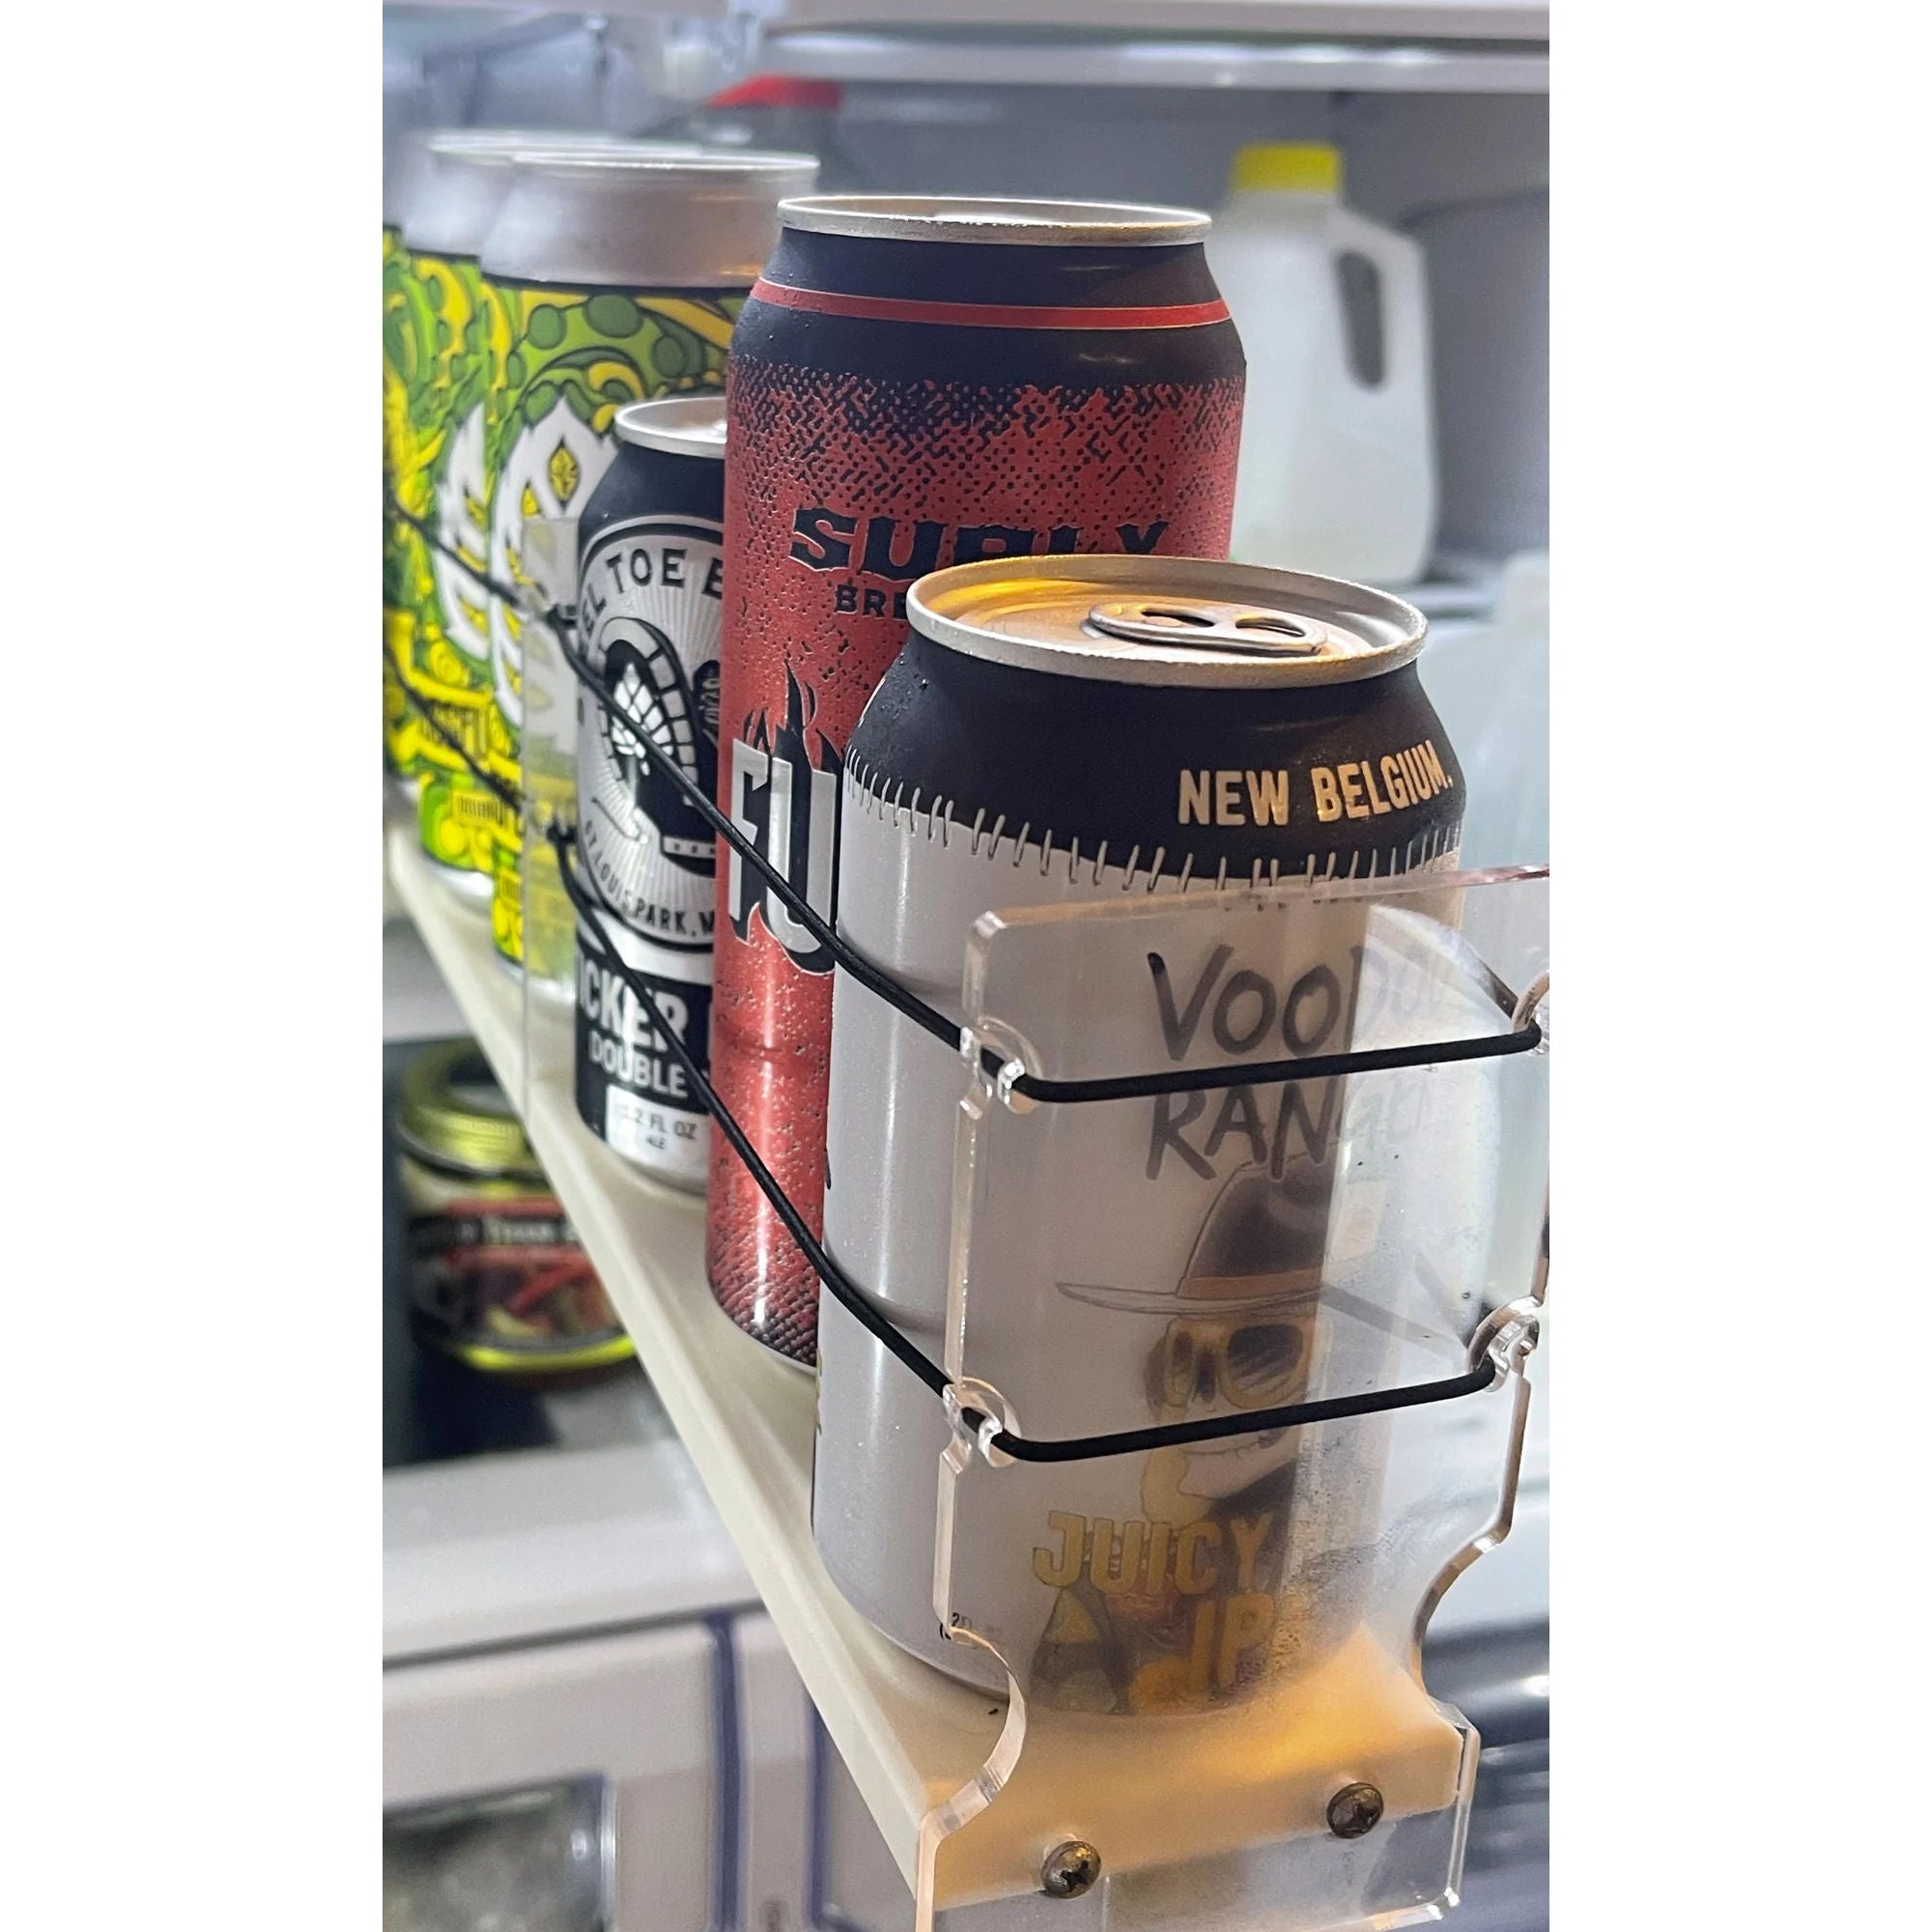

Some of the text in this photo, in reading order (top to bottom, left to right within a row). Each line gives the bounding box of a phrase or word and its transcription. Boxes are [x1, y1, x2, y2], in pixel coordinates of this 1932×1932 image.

[606, 548, 688, 595] TOE
[1178, 769, 1290, 826] NEW
[589, 1029, 689, 1098] DOUBLE
[673, 1121, 698, 1141] OZ
[1033, 1510, 1274, 1595] JUICY
